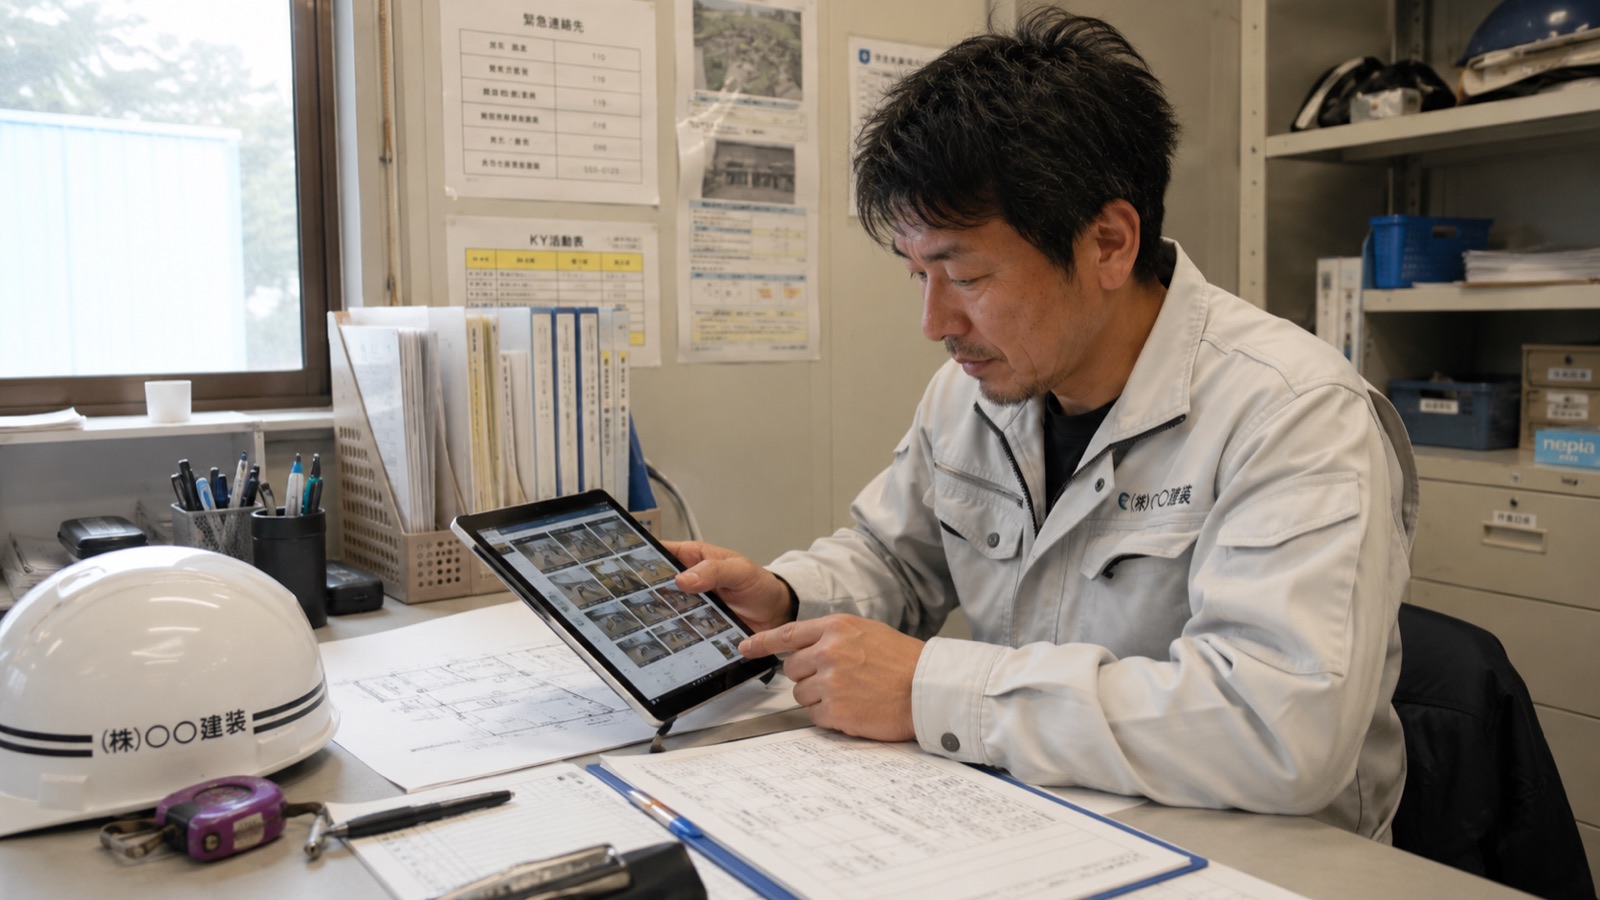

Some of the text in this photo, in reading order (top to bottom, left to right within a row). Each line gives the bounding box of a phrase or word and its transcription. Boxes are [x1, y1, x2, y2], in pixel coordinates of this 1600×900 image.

[523, 13, 585, 34] 緊急連絡先
[529, 234, 585, 248] KY活動表
[1543, 437, 1596, 455] nepia
